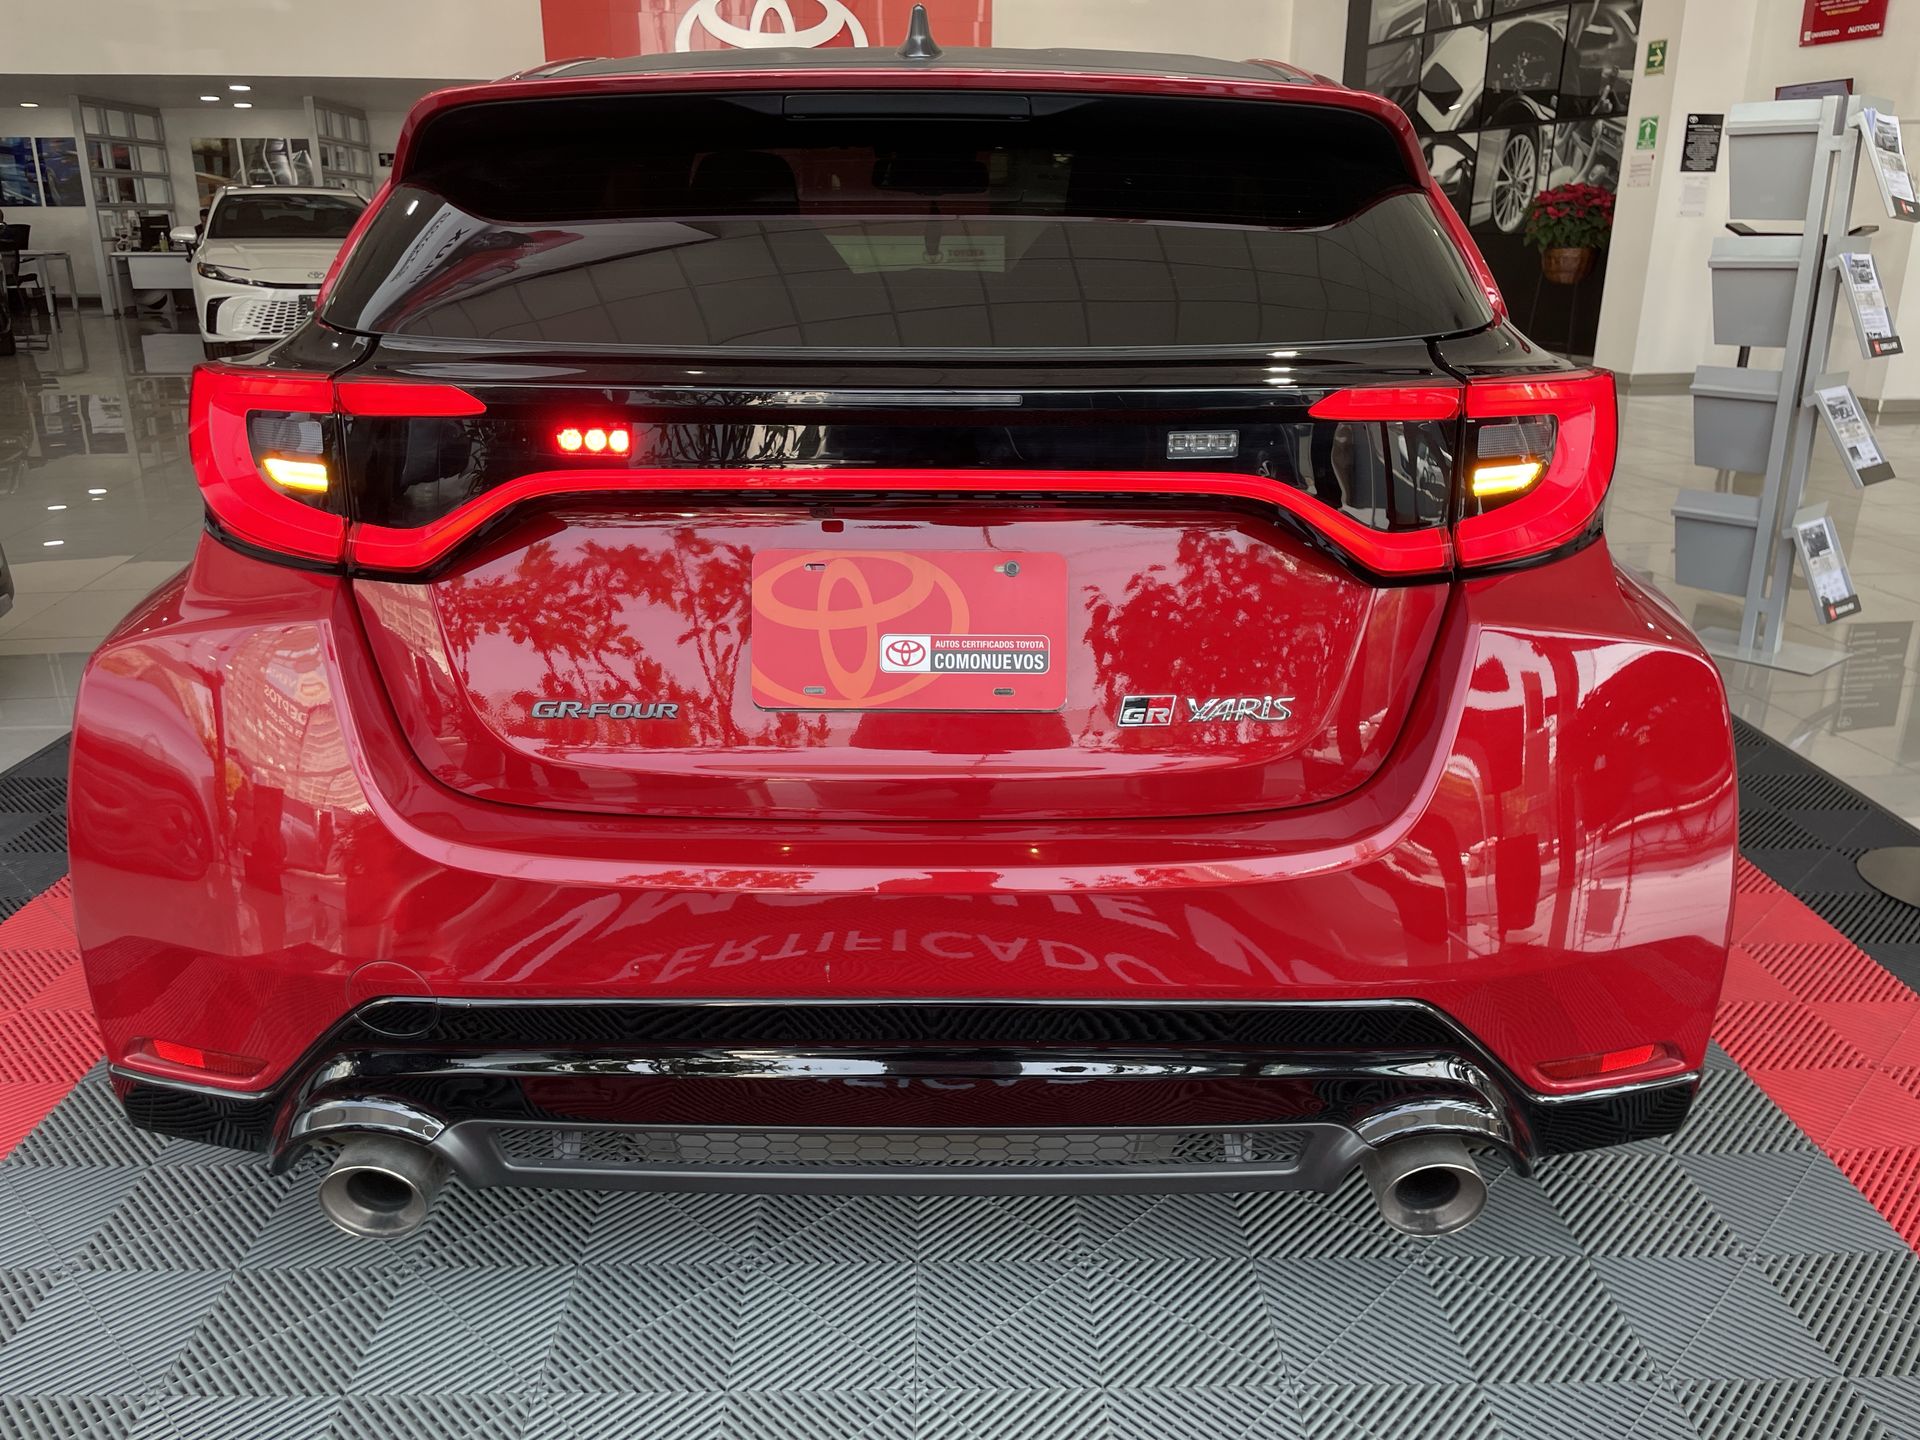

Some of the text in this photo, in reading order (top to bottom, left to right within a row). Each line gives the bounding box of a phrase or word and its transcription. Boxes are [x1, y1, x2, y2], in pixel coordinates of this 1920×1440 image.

[935, 640, 1044, 649] AUTOS CERTIFICADOS TOYOTA
[934, 653, 1045, 670] COMONUEVOS
[531, 701, 679, 719] GR-FOUR
[1121, 707, 1170, 724] GR
[1187, 696, 1295, 722] YARIS
